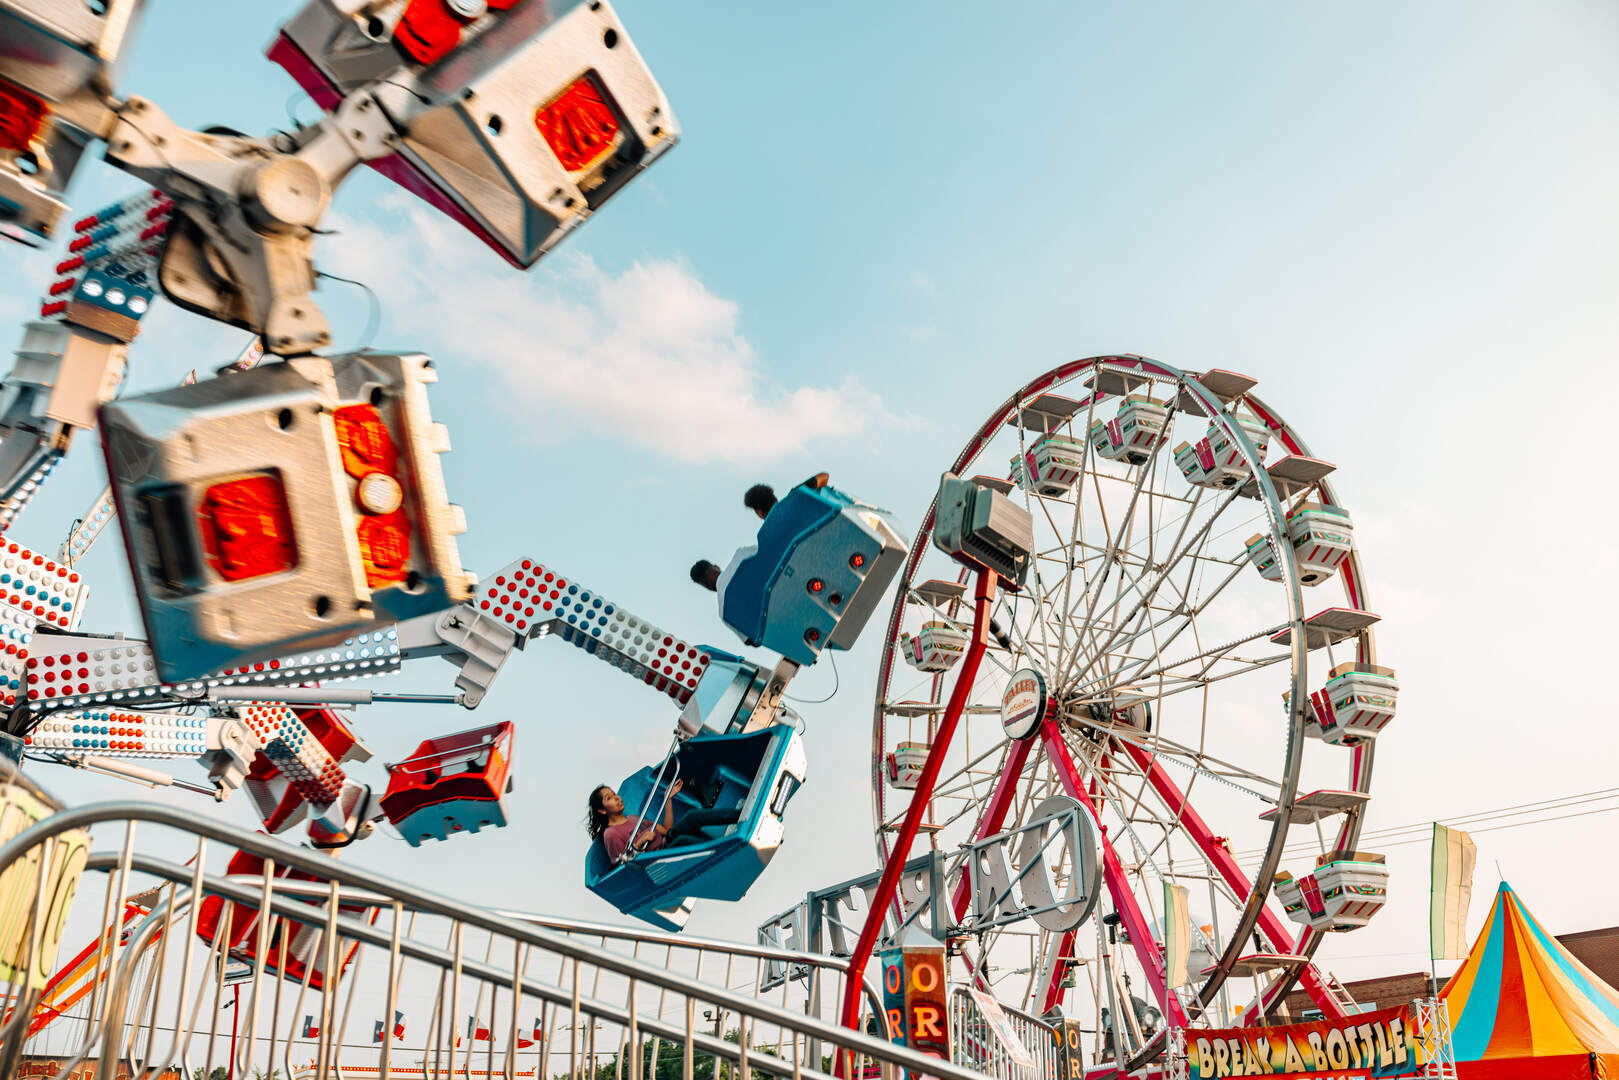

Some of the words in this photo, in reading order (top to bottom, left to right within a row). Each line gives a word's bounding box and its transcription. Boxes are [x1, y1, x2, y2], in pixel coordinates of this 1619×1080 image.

[1196, 1035, 1275, 1078] BREAK
[1285, 1032, 1306, 1073] A
[1307, 1016, 1408, 1073] BOTTLE
